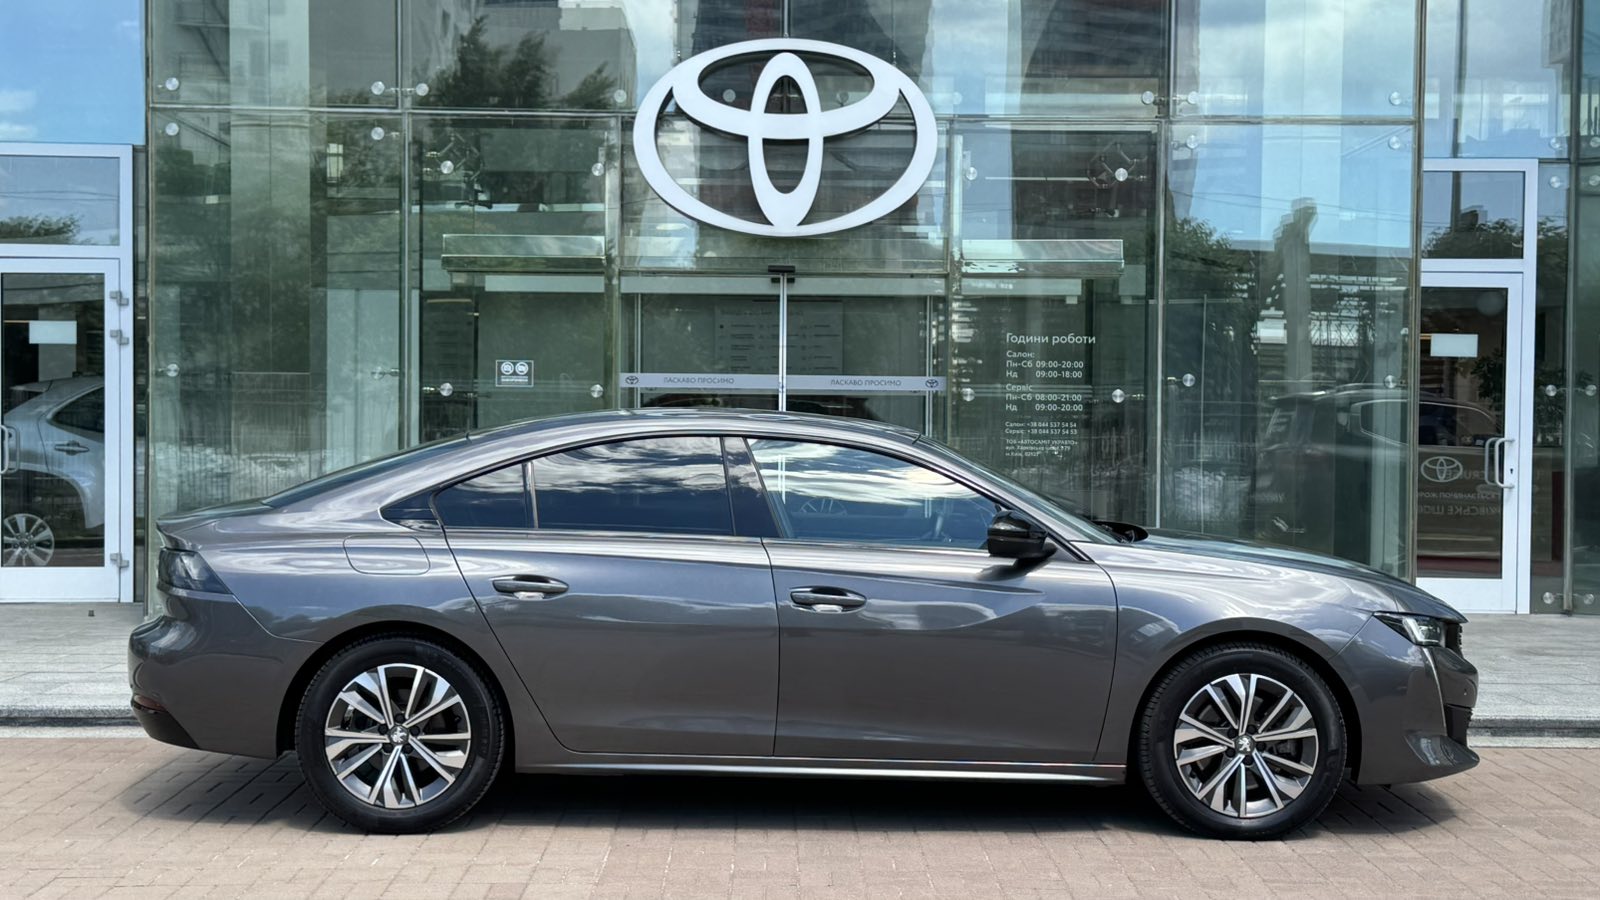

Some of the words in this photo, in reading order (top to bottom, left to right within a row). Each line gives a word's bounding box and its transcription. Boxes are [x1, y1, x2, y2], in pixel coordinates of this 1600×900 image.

[1006, 332, 1049, 344] Години
[1052, 333, 1096, 346] роботи
[1006, 350, 1035, 358] Салон:
[1006, 360, 1033, 368] Пн-Сб
[1035, 360, 1084, 368] 09:00-20:00
[1006, 370, 1018, 378] Нд
[1035, 370, 1083, 378] 09:00-18:00
[864, 379, 902, 387] ПРОСИМО
[1005, 393, 1033, 401] Пн-Сб
[1035, 393, 1082, 401] 08:00-21:00
[1005, 403, 1018, 411] Нд
[1035, 403, 1083, 411] 09:00-20:00
